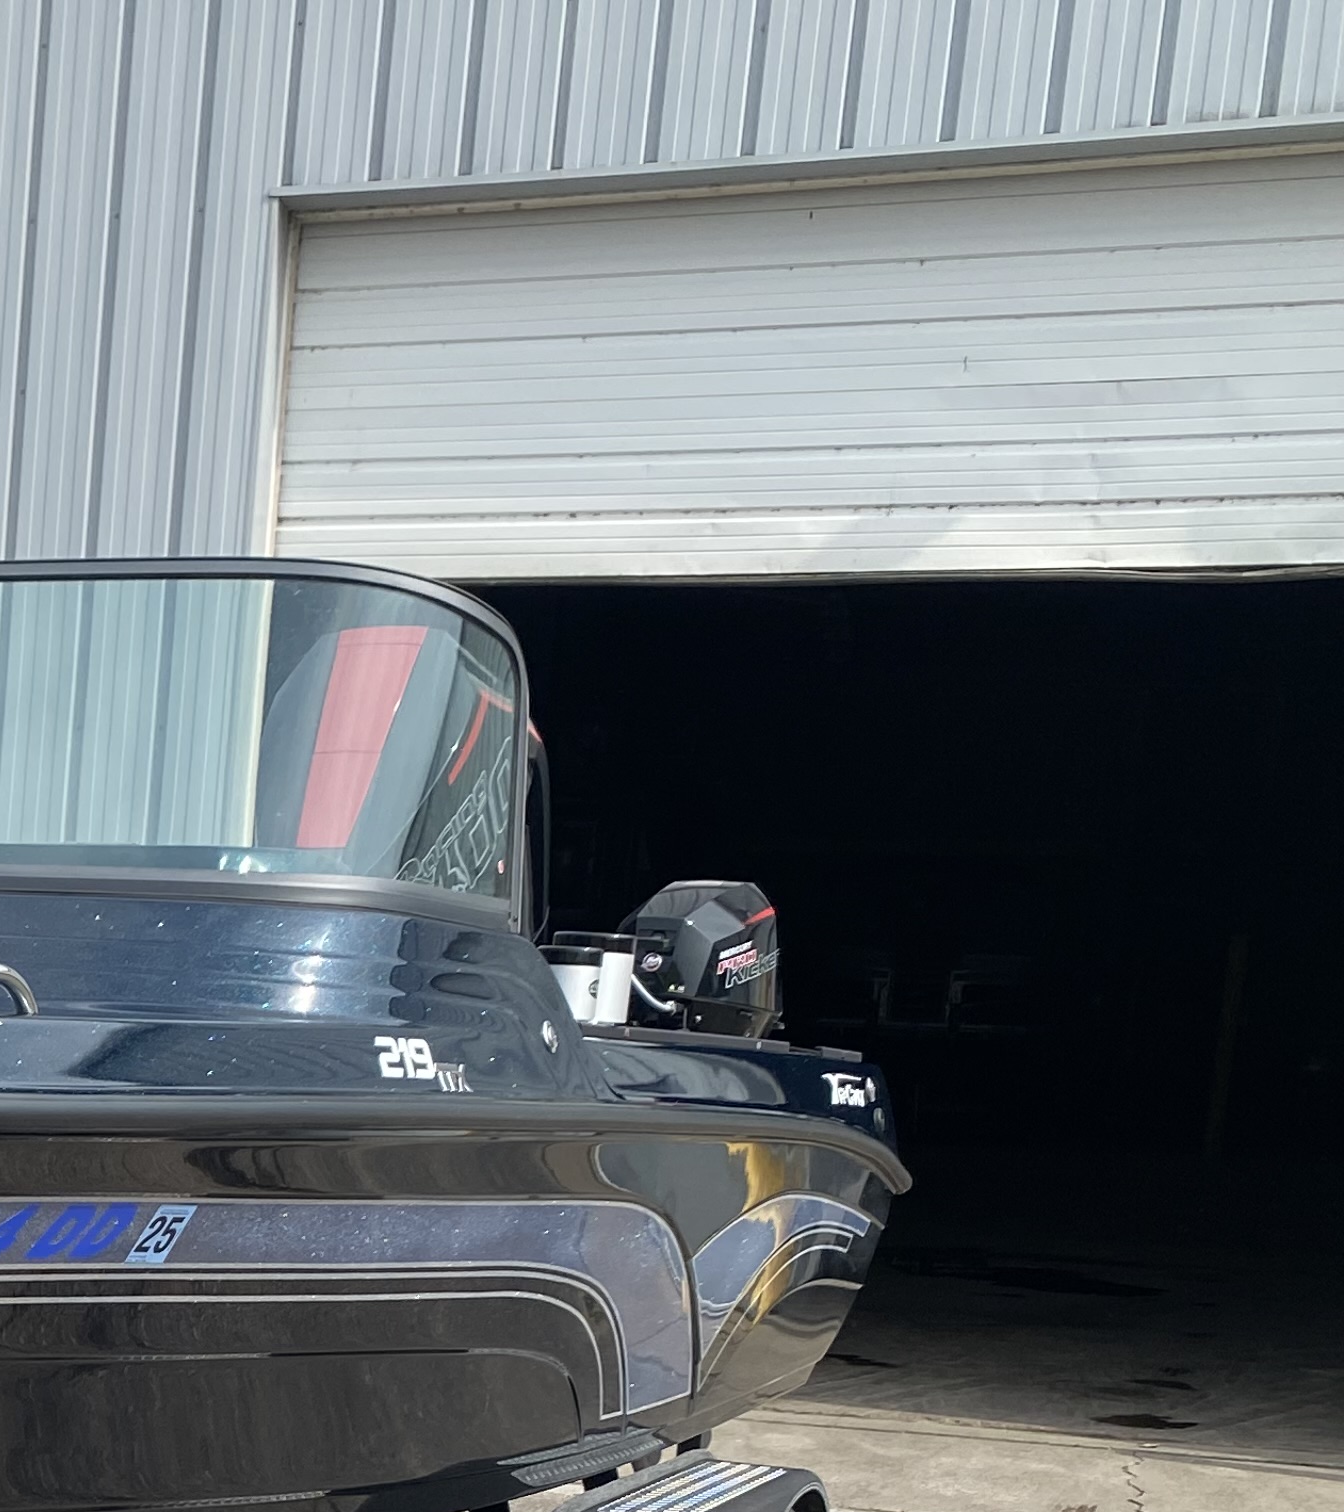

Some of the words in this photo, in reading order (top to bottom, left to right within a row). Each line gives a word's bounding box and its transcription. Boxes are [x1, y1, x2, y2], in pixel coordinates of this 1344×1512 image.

[374, 1035, 436, 1080] 219
[26, 1203, 138, 1261] DD
[132, 1214, 187, 1255] 25
